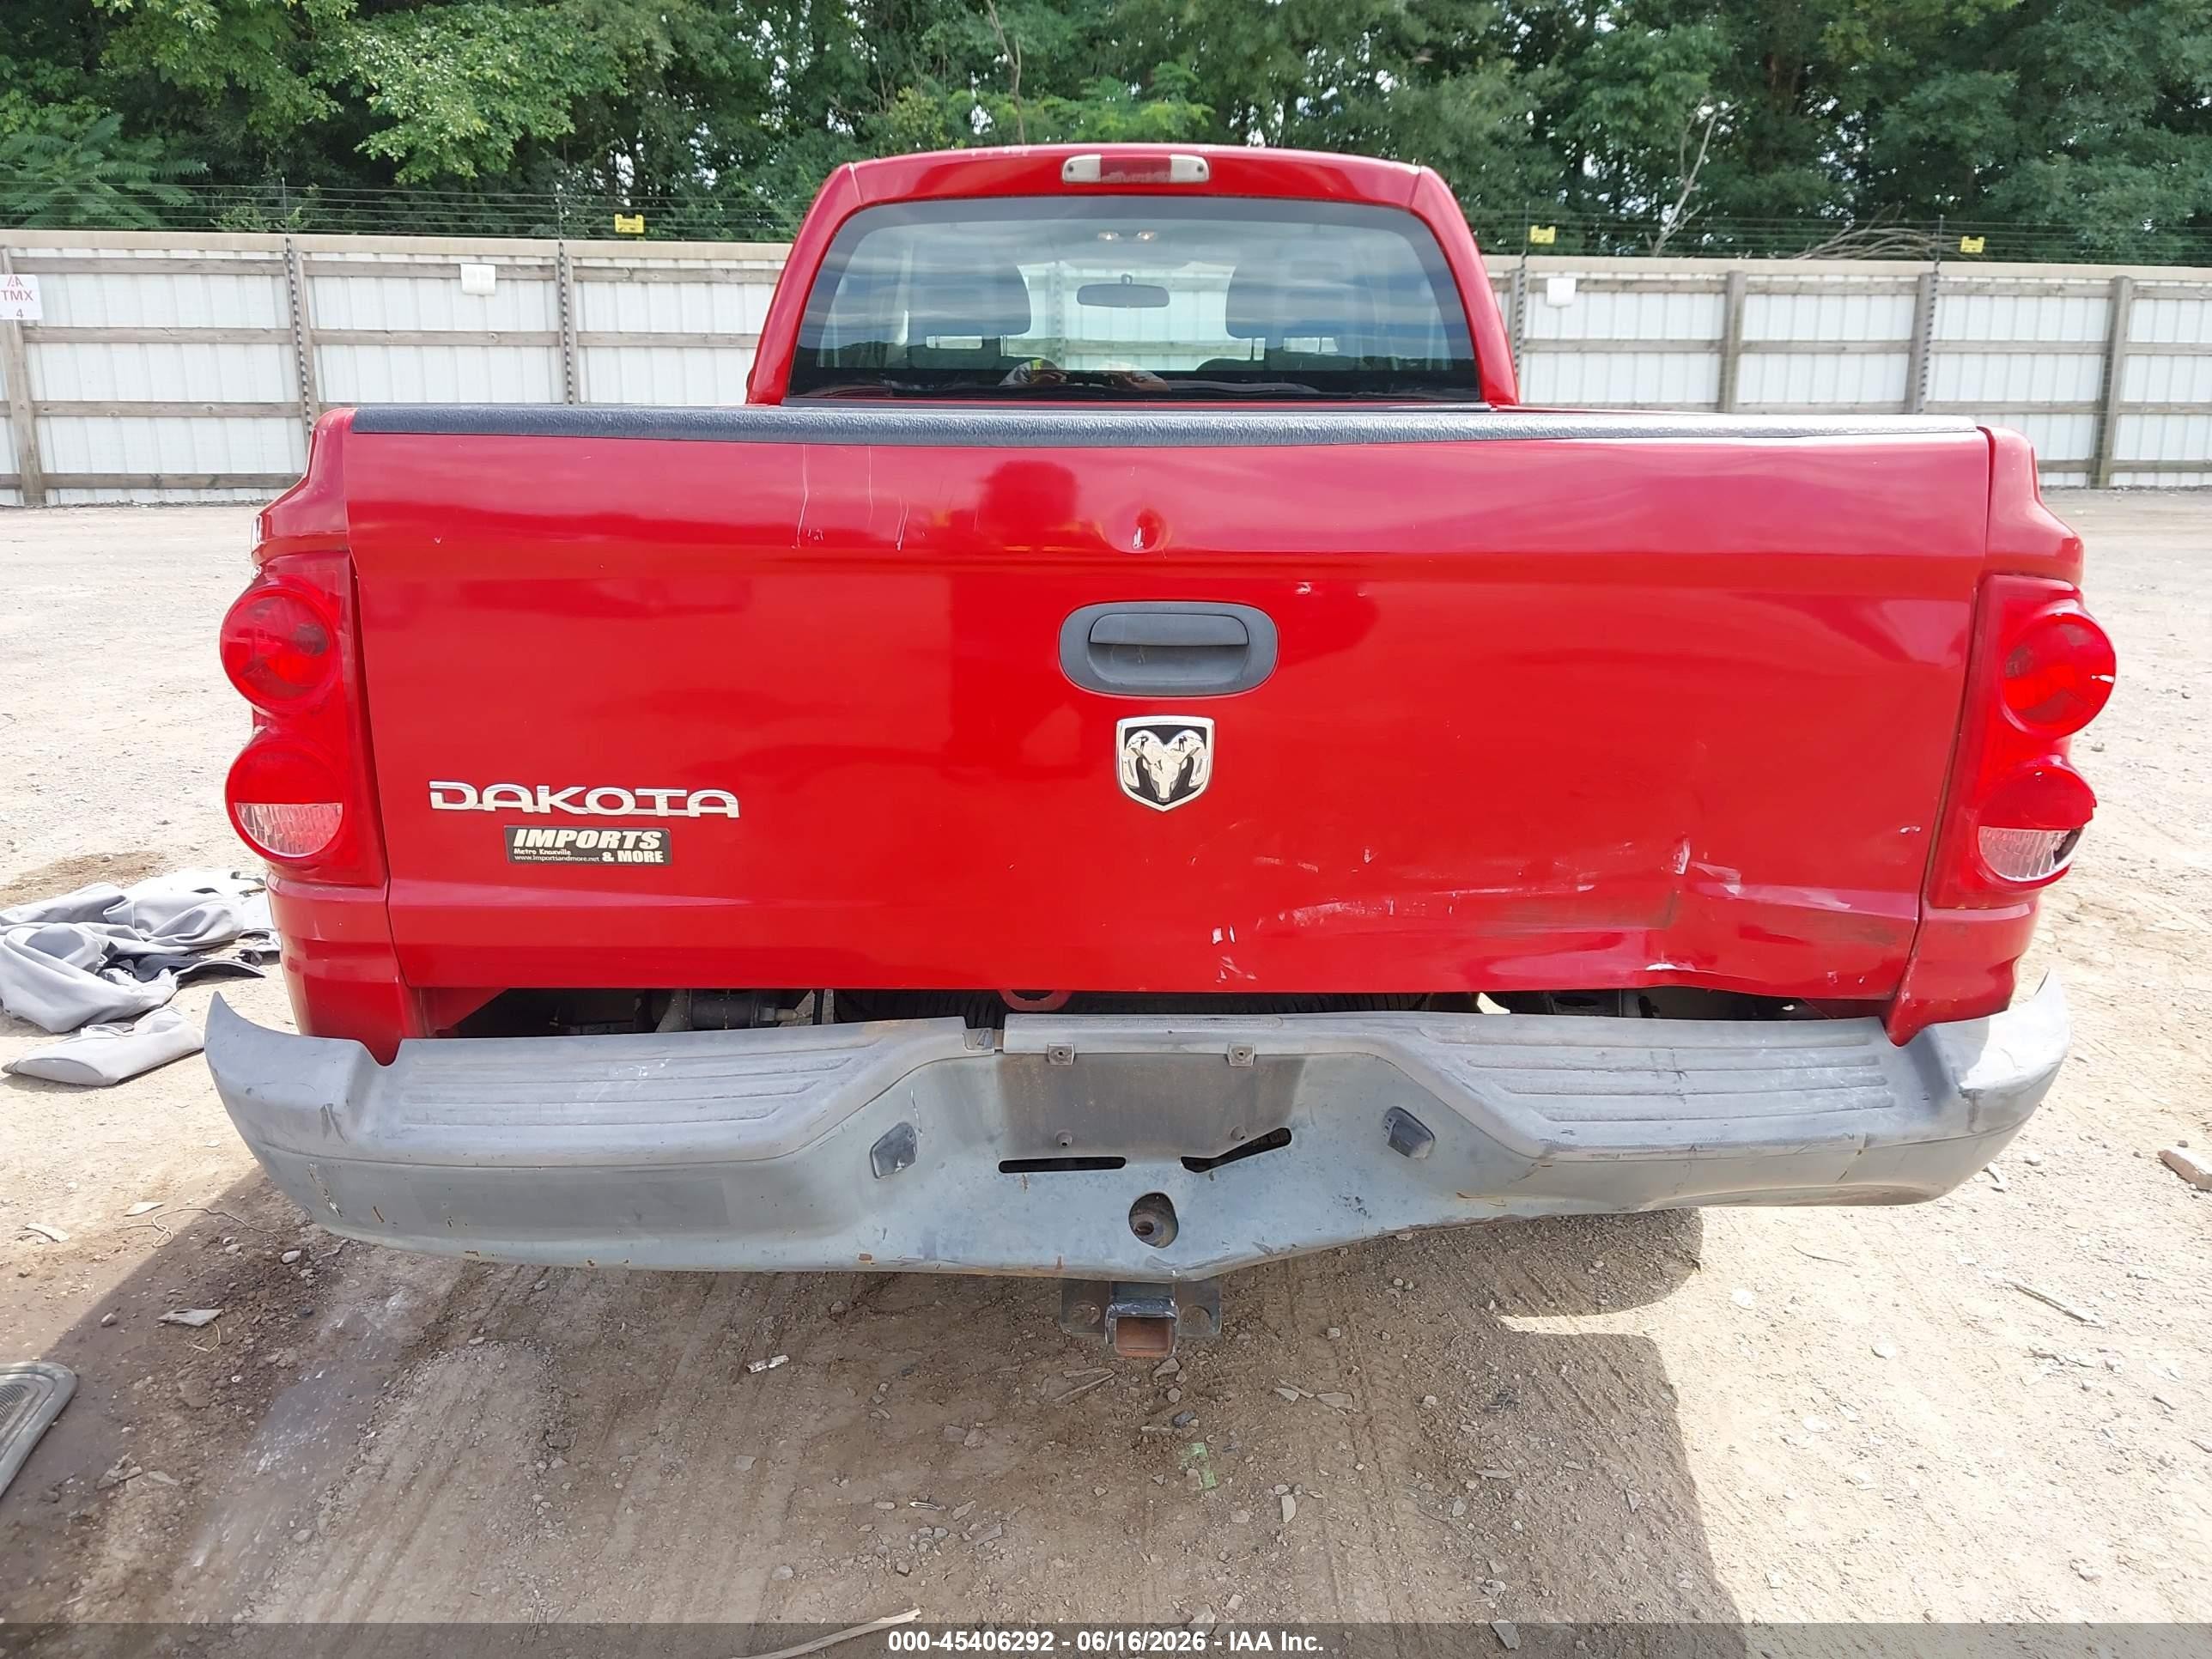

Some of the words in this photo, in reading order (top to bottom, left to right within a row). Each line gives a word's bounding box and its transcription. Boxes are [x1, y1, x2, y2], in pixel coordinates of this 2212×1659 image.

[428, 780, 740, 818] DAKOTA
[514, 829, 662, 849] IMPORTS
[602, 851, 615, 863] &
[617, 850, 665, 863] MORE
